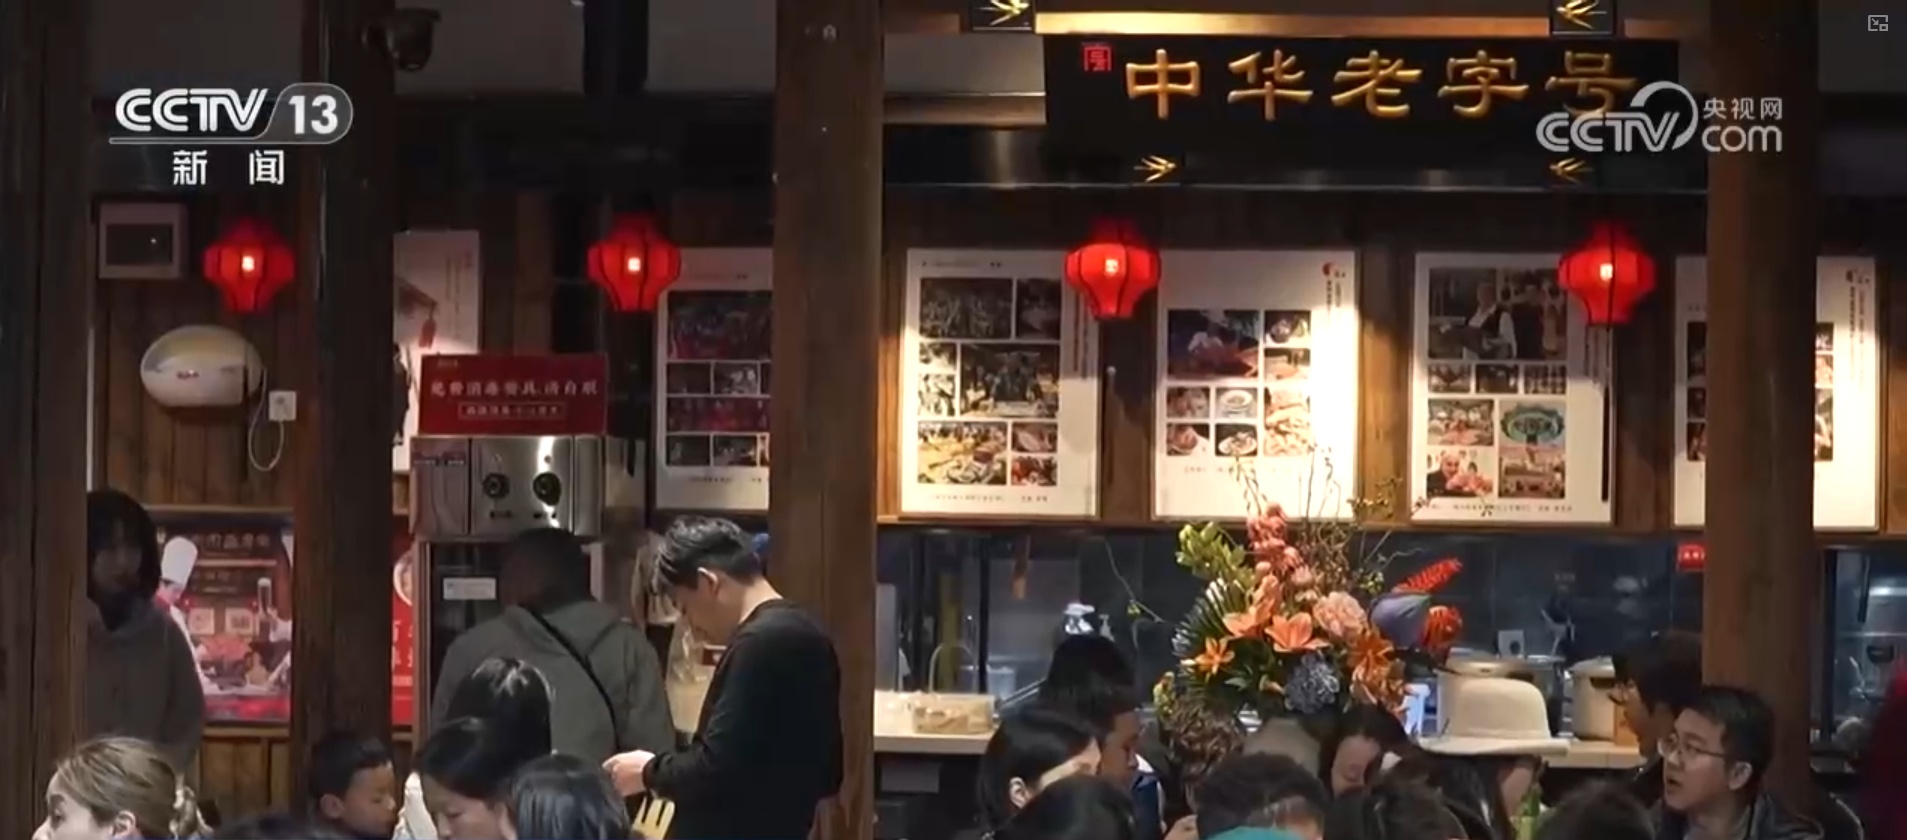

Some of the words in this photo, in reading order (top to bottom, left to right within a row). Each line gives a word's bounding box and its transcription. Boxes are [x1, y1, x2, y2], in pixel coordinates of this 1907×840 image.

[1125, 49, 1634, 120] 中华老字号
